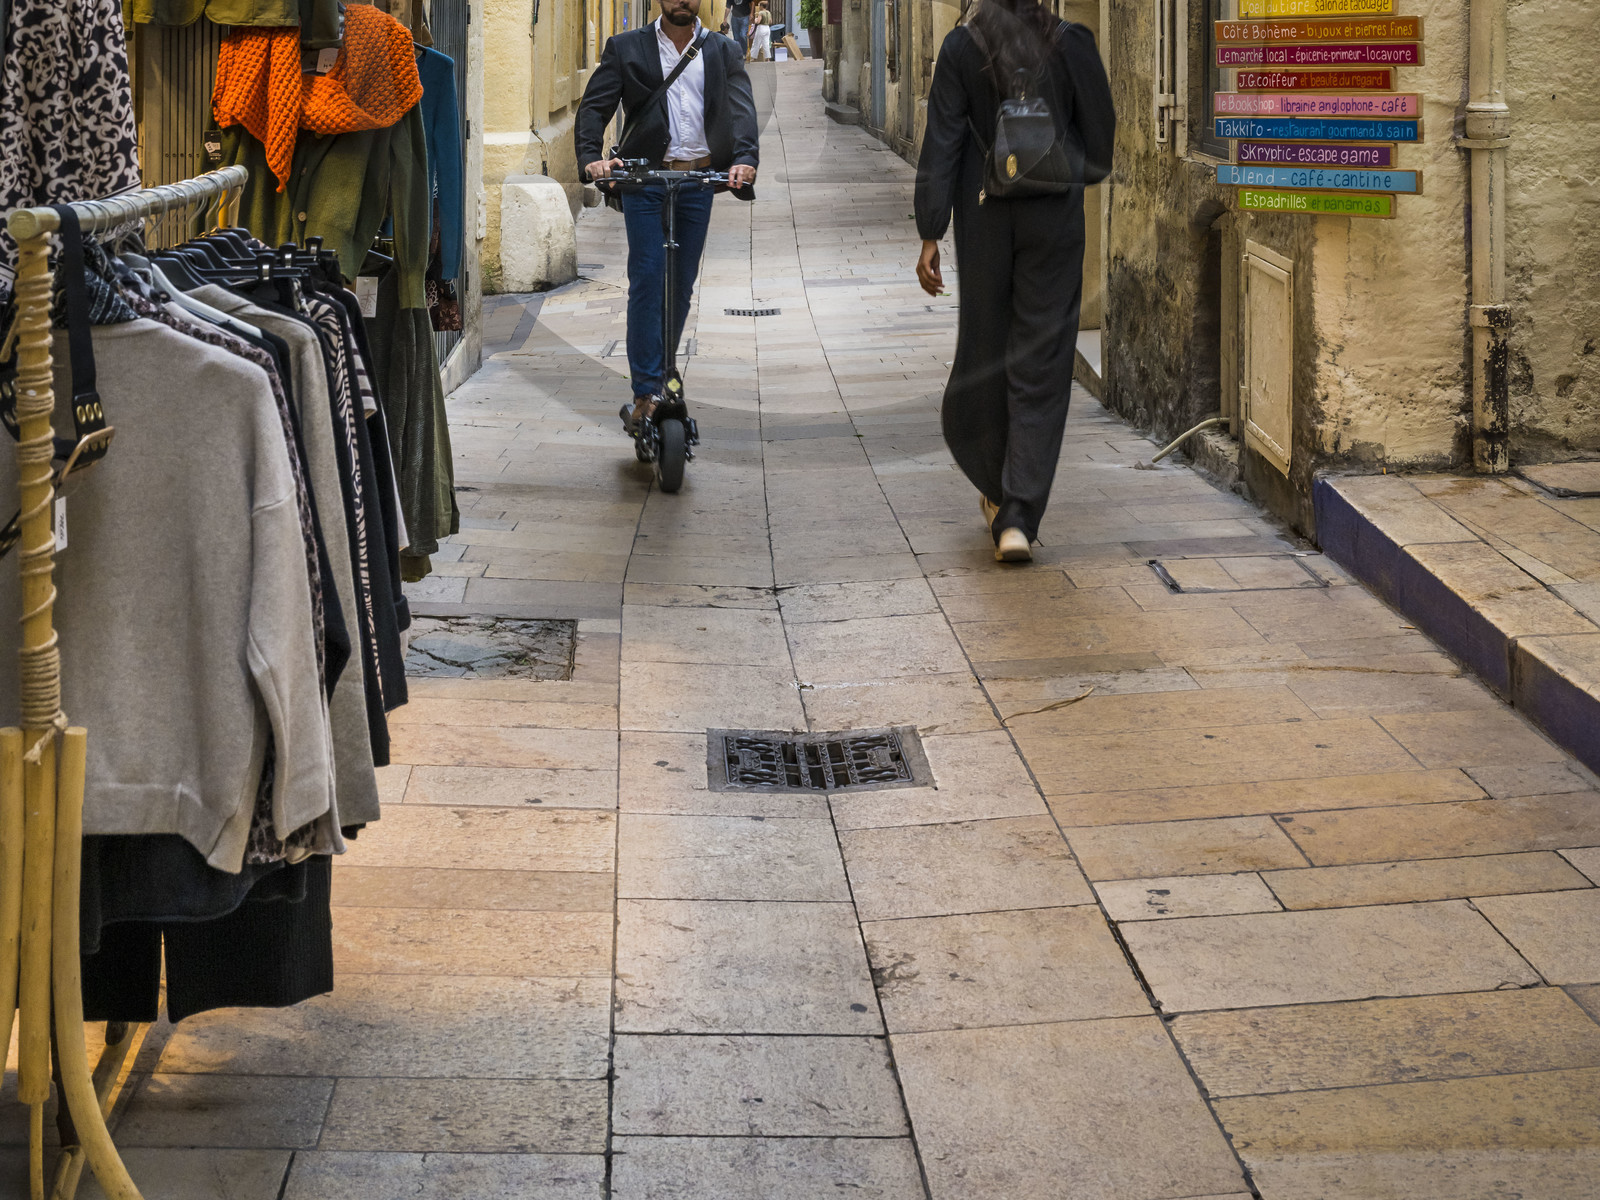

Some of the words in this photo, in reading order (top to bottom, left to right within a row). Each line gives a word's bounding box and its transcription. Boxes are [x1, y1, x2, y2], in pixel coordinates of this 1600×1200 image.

[1267, 1, 1278, 13] du
[1223, 24, 1248, 39] Côté
[1252, 24, 1296, 39] Bohème
[1307, 24, 1341, 38] bijoux
[1345, 23, 1353, 37] et
[1356, 24, 1386, 38] pierres
[1391, 22, 1412, 36] fines
[1266, 48, 1287, 62] local
[1300, 74, 1308, 87] et
[1311, 73, 1338, 87] beauté
[1340, 73, 1350, 86] du
[1352, 73, 1382, 88] regard
[1381, 97, 1407, 112] café
[1218, 120, 1263, 136] Takkito
[1272, 120, 1326, 137] restaurant
[1328, 122, 1375, 138] gourmand
[1386, 124, 1414, 138] sain
[1340, 150, 1379, 164] game
[1231, 166, 1274, 184] Blend
[1291, 169, 1323, 186] café
[1334, 172, 1391, 188] cantine
[1245, 192, 1306, 209] Espadrilles
[1312, 196, 1321, 209] et
[1324, 199, 1380, 213] panamas
